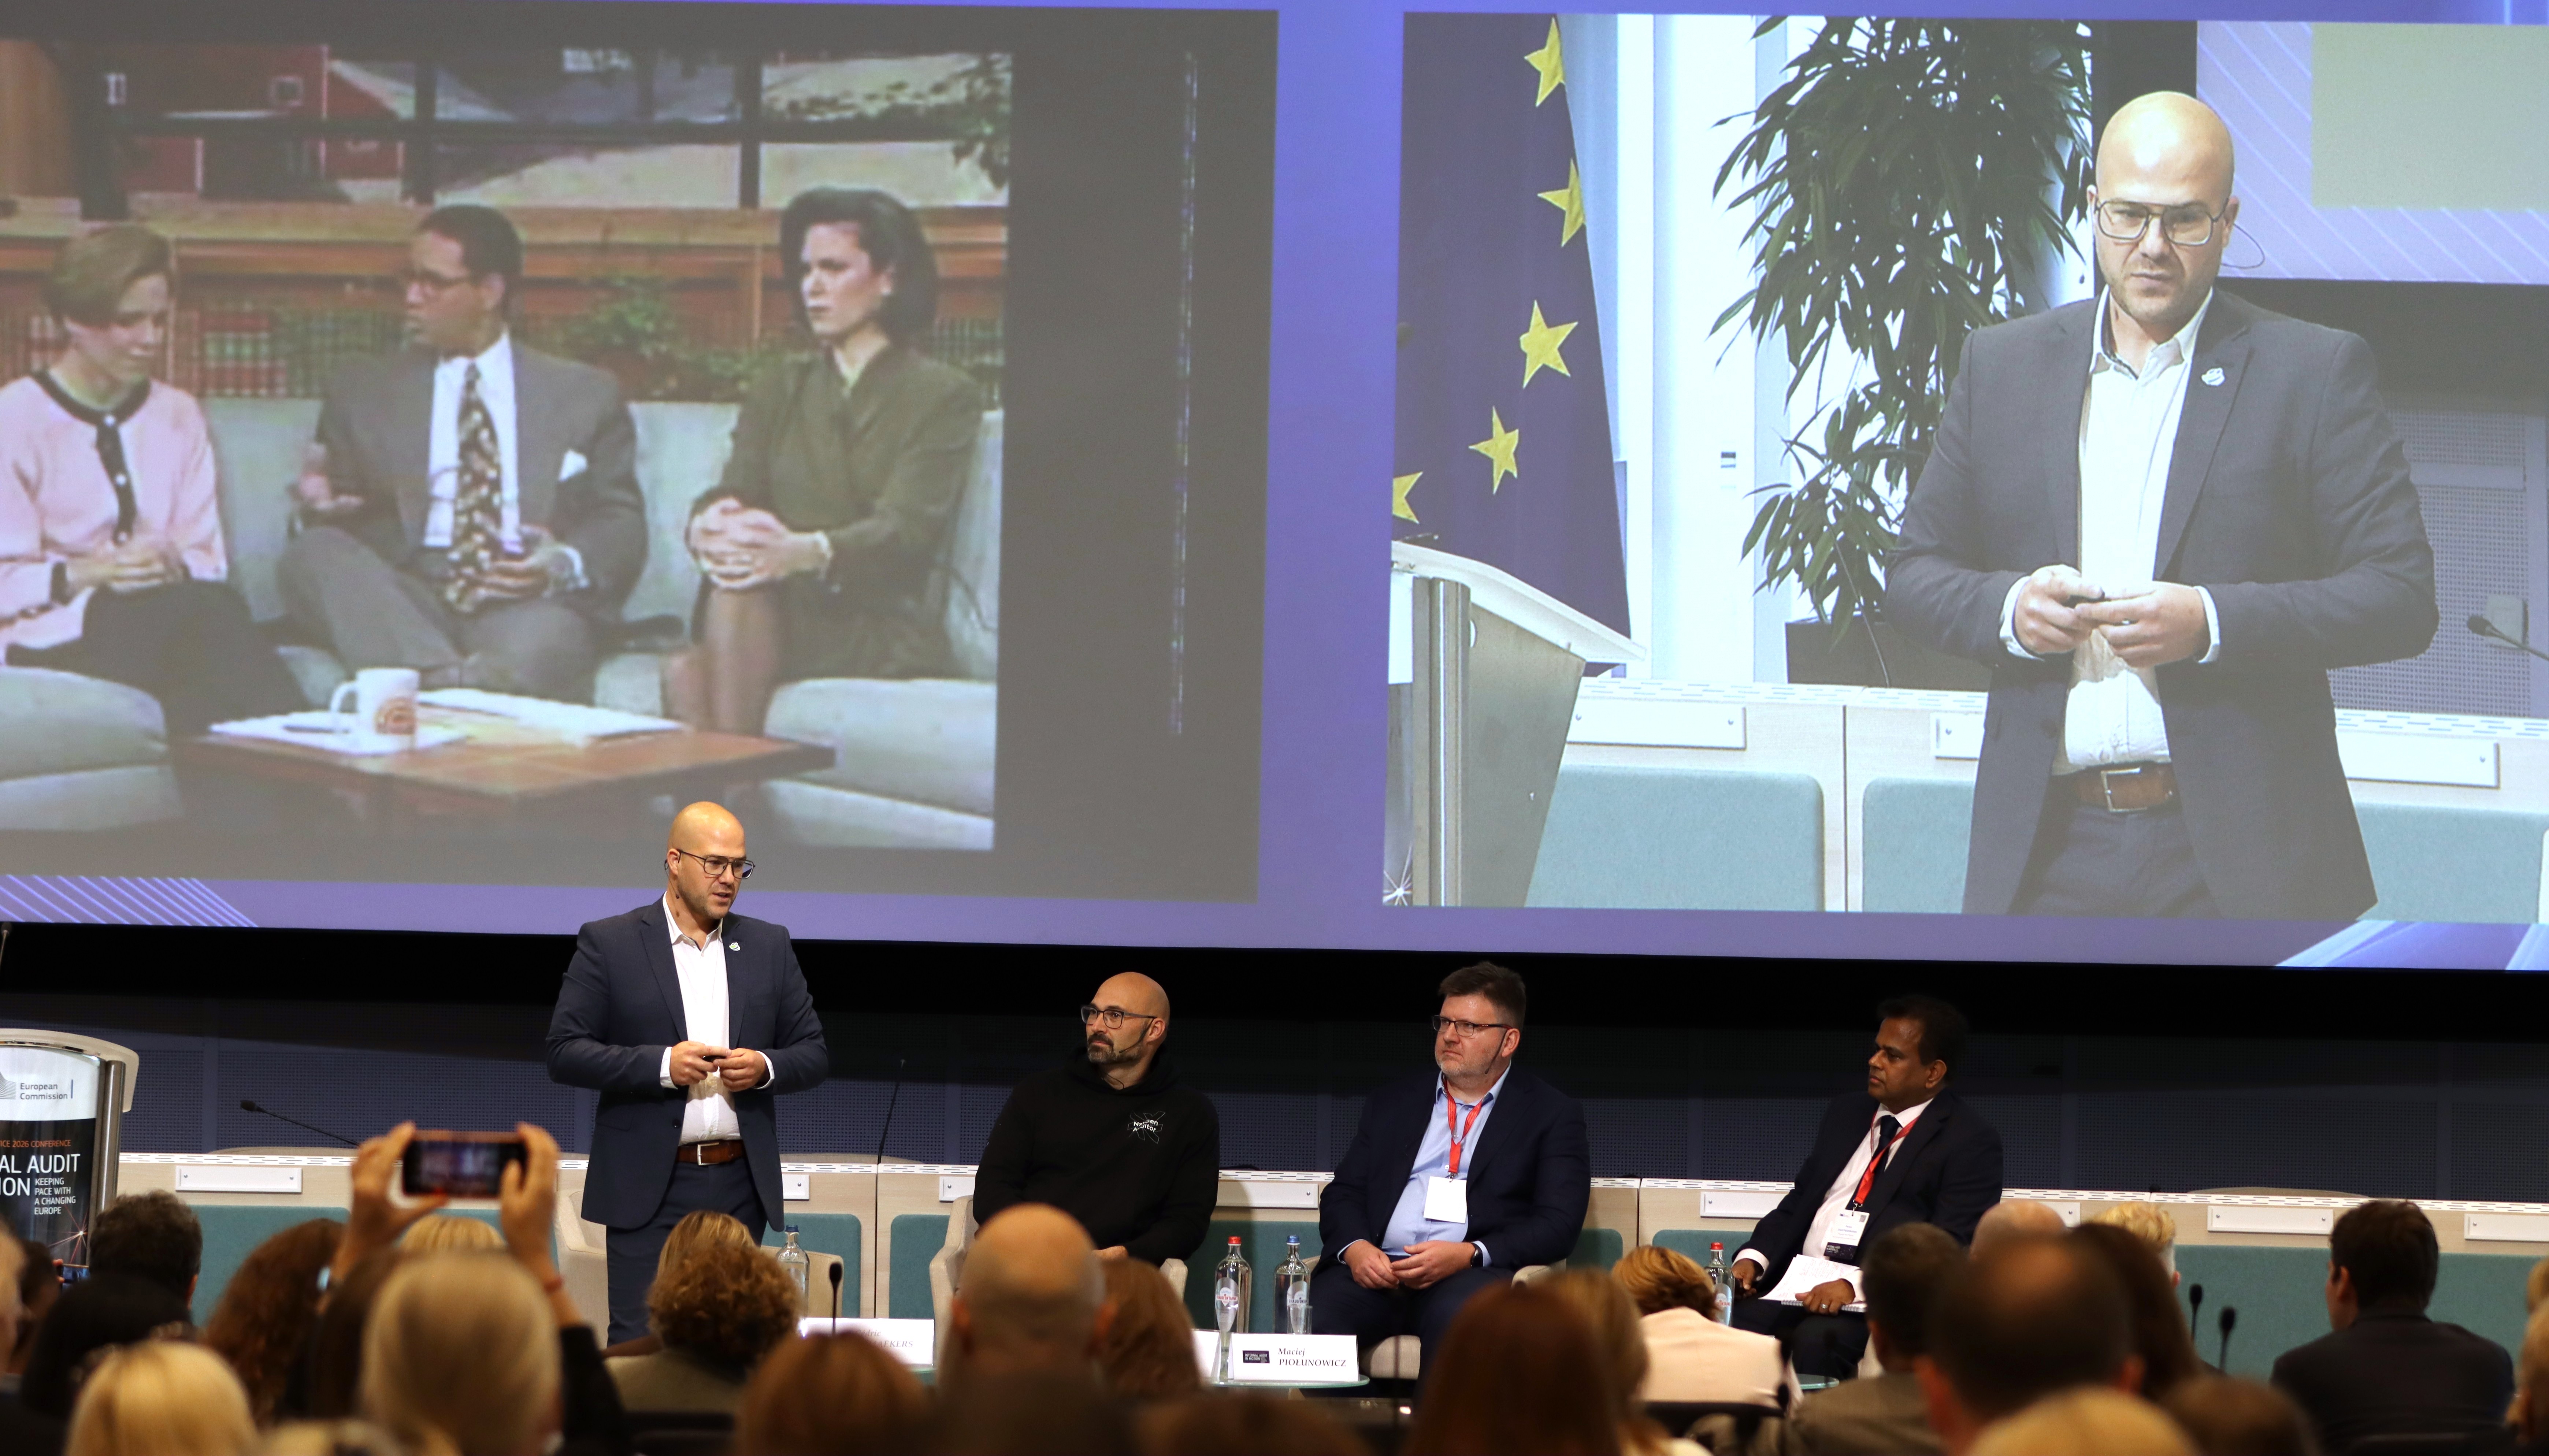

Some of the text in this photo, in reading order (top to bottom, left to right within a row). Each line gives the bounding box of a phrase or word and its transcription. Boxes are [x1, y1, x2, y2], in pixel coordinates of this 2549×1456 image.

[20, 1083, 58, 1091] European
[27, 1154, 81, 1173] AUDIT
[41, 1196, 76, 1205] CHANGING
[34, 1207, 62, 1215] EUROPE
[1278, 1348, 1305, 1357] Maciej
